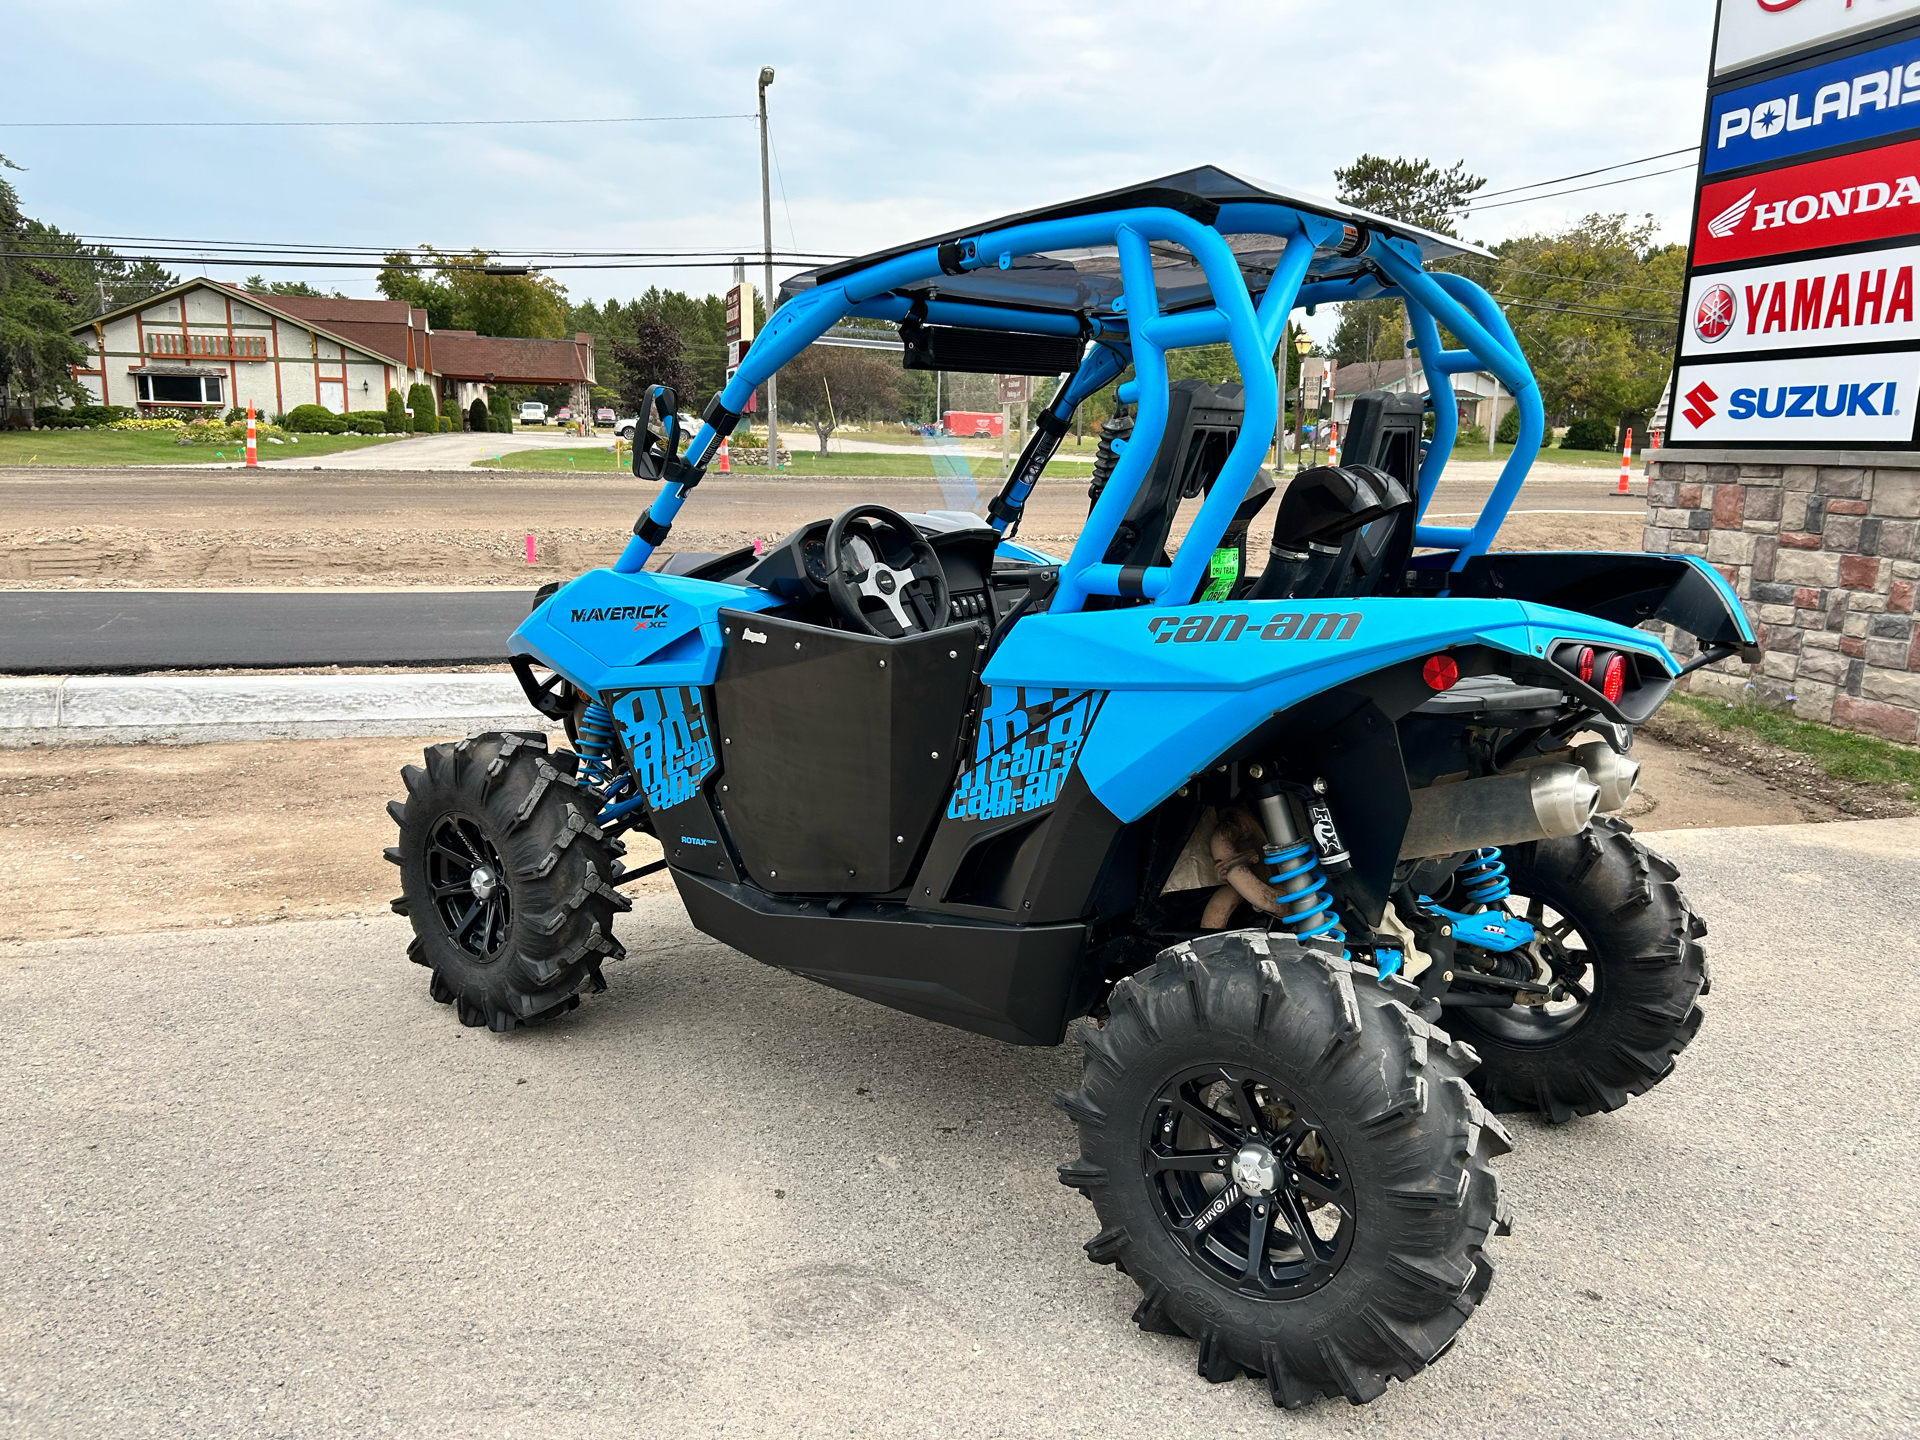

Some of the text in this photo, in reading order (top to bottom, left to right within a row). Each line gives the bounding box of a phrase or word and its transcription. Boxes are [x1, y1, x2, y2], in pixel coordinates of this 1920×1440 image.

[1751, 175, 1920, 231] HONDA
[1745, 265, 1914, 336] YAMAHA
[1727, 381, 1898, 420] SUZUKI
[570, 604, 671, 623] MAVERICK
[1148, 613, 1363, 644] can-am
[681, 835, 707, 847] ROTAX
